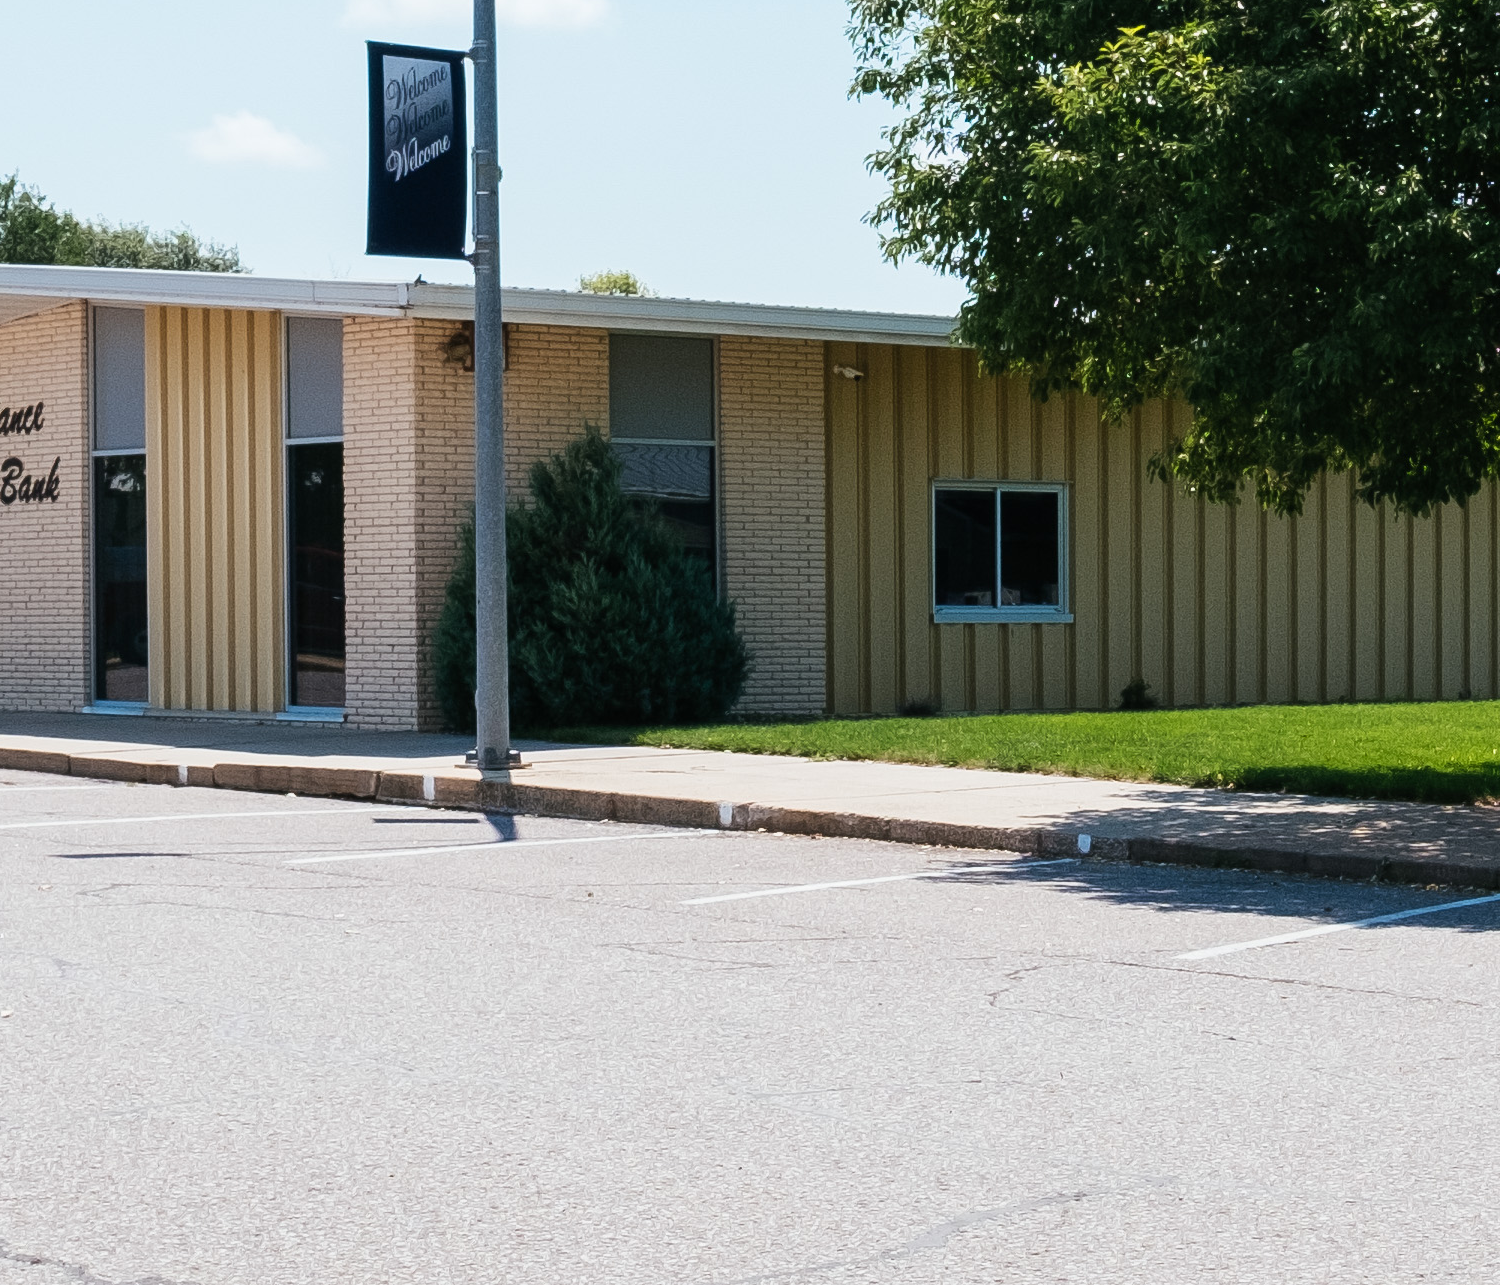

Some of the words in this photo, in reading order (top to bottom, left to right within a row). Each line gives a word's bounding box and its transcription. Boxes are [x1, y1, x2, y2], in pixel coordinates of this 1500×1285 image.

[386, 66, 447, 110] Welcome
[386, 99, 449, 145] Welcome
[386, 135, 450, 182] Welcome
[0, 456, 61, 505] Bank
